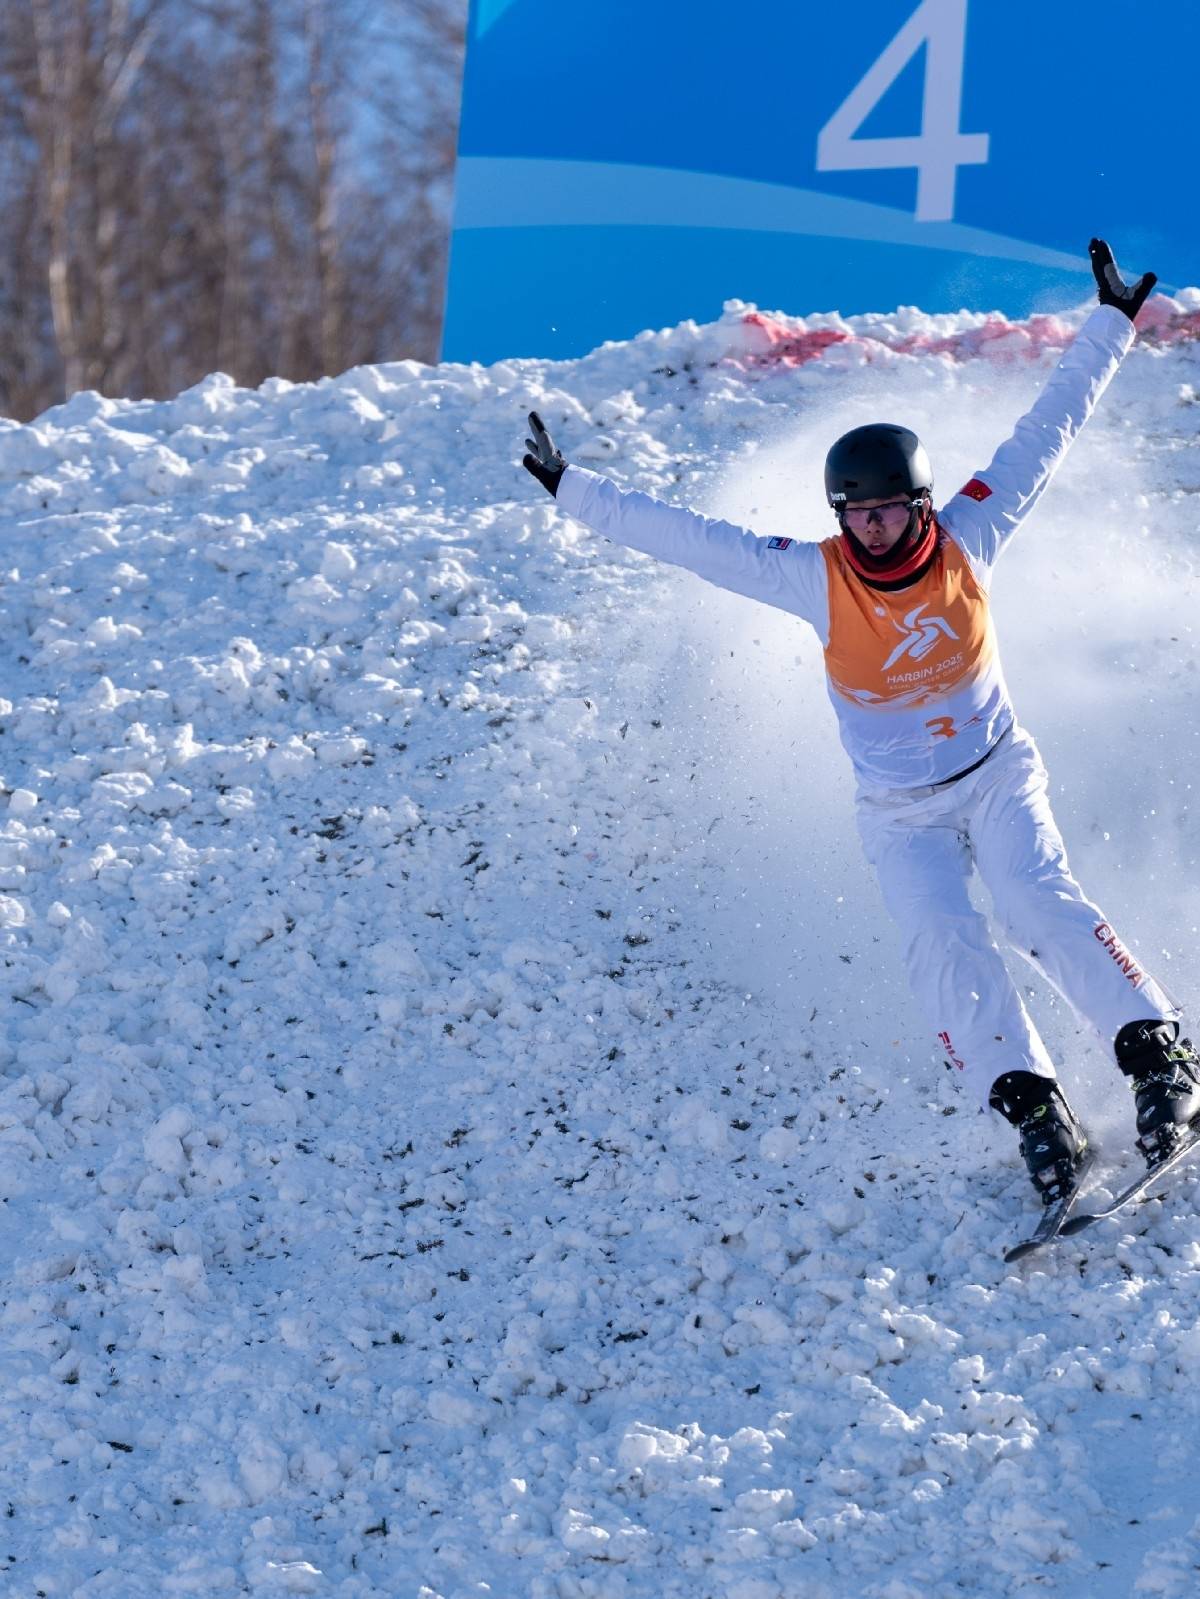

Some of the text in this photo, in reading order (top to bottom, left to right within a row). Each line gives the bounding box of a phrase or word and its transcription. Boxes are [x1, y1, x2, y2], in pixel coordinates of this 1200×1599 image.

[816, 0, 989, 222] 4
[887, 666, 933, 684] HARBIN
[936, 652, 963, 673] 2025
[1094, 923, 1143, 989] CHINA
